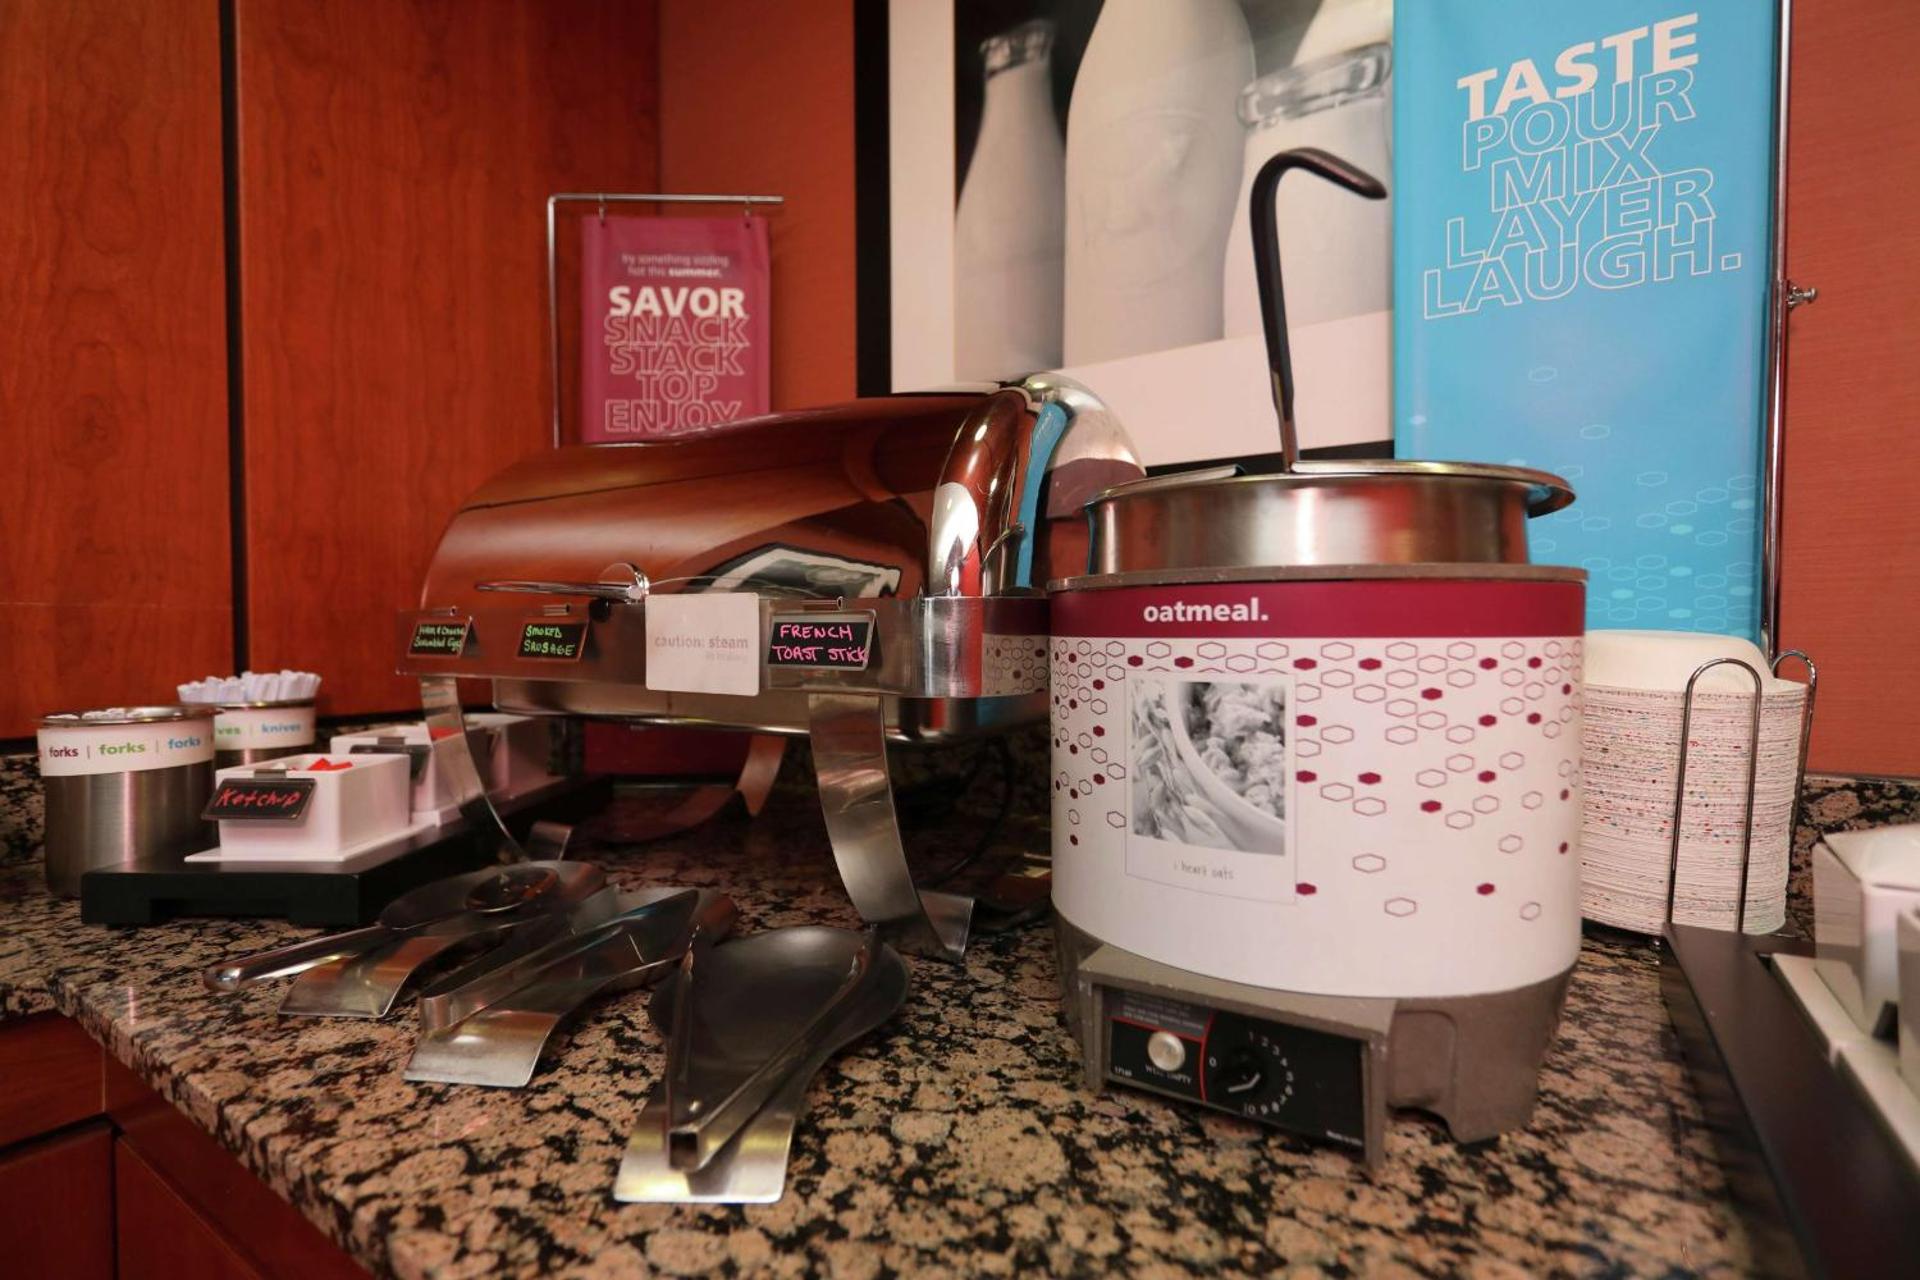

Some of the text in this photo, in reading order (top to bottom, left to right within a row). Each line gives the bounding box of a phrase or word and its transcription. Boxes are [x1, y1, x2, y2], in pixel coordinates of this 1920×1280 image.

[1457, 12, 1698, 121] TASTE
[1463, 67, 1696, 171] POUR
[1491, 124, 1663, 212] MIX
[1447, 168, 1717, 269] LAYER
[1424, 217, 1742, 320] LAUGH.
[609, 286, 747, 319] SAVOR
[604, 314, 750, 347] SNACK
[610, 341, 745, 375] STACK
[636, 370, 719, 404] TOP
[605, 399, 742, 433] ENJOY
[1143, 597, 1269, 622] oatmeal.
[780, 624, 853, 641] FRENCH
[709, 635, 749, 649] steam
[771, 645, 824, 662] TOAST
[217, 726, 241, 737] ves
[49, 745, 79, 759] forks
[99, 741, 146, 756] forks
[216, 787, 301, 808] Ketchup
[1248, 1031, 1254, 1041] 1
[1261, 1037, 1270, 1048] 2
[1272, 1045, 1280, 1056] 3
[1208, 1056, 1218, 1068] 0
[1280, 1057, 1288, 1067] 4
[1286, 1071, 1294, 1082] 5
[1285, 1085, 1294, 1096] 6
[1271, 1101, 1280, 1113] 8
[1279, 1094, 1287, 1105] 7
[1243, 1103, 1257, 1116] 10
[1260, 1104, 1269, 1115] 9
